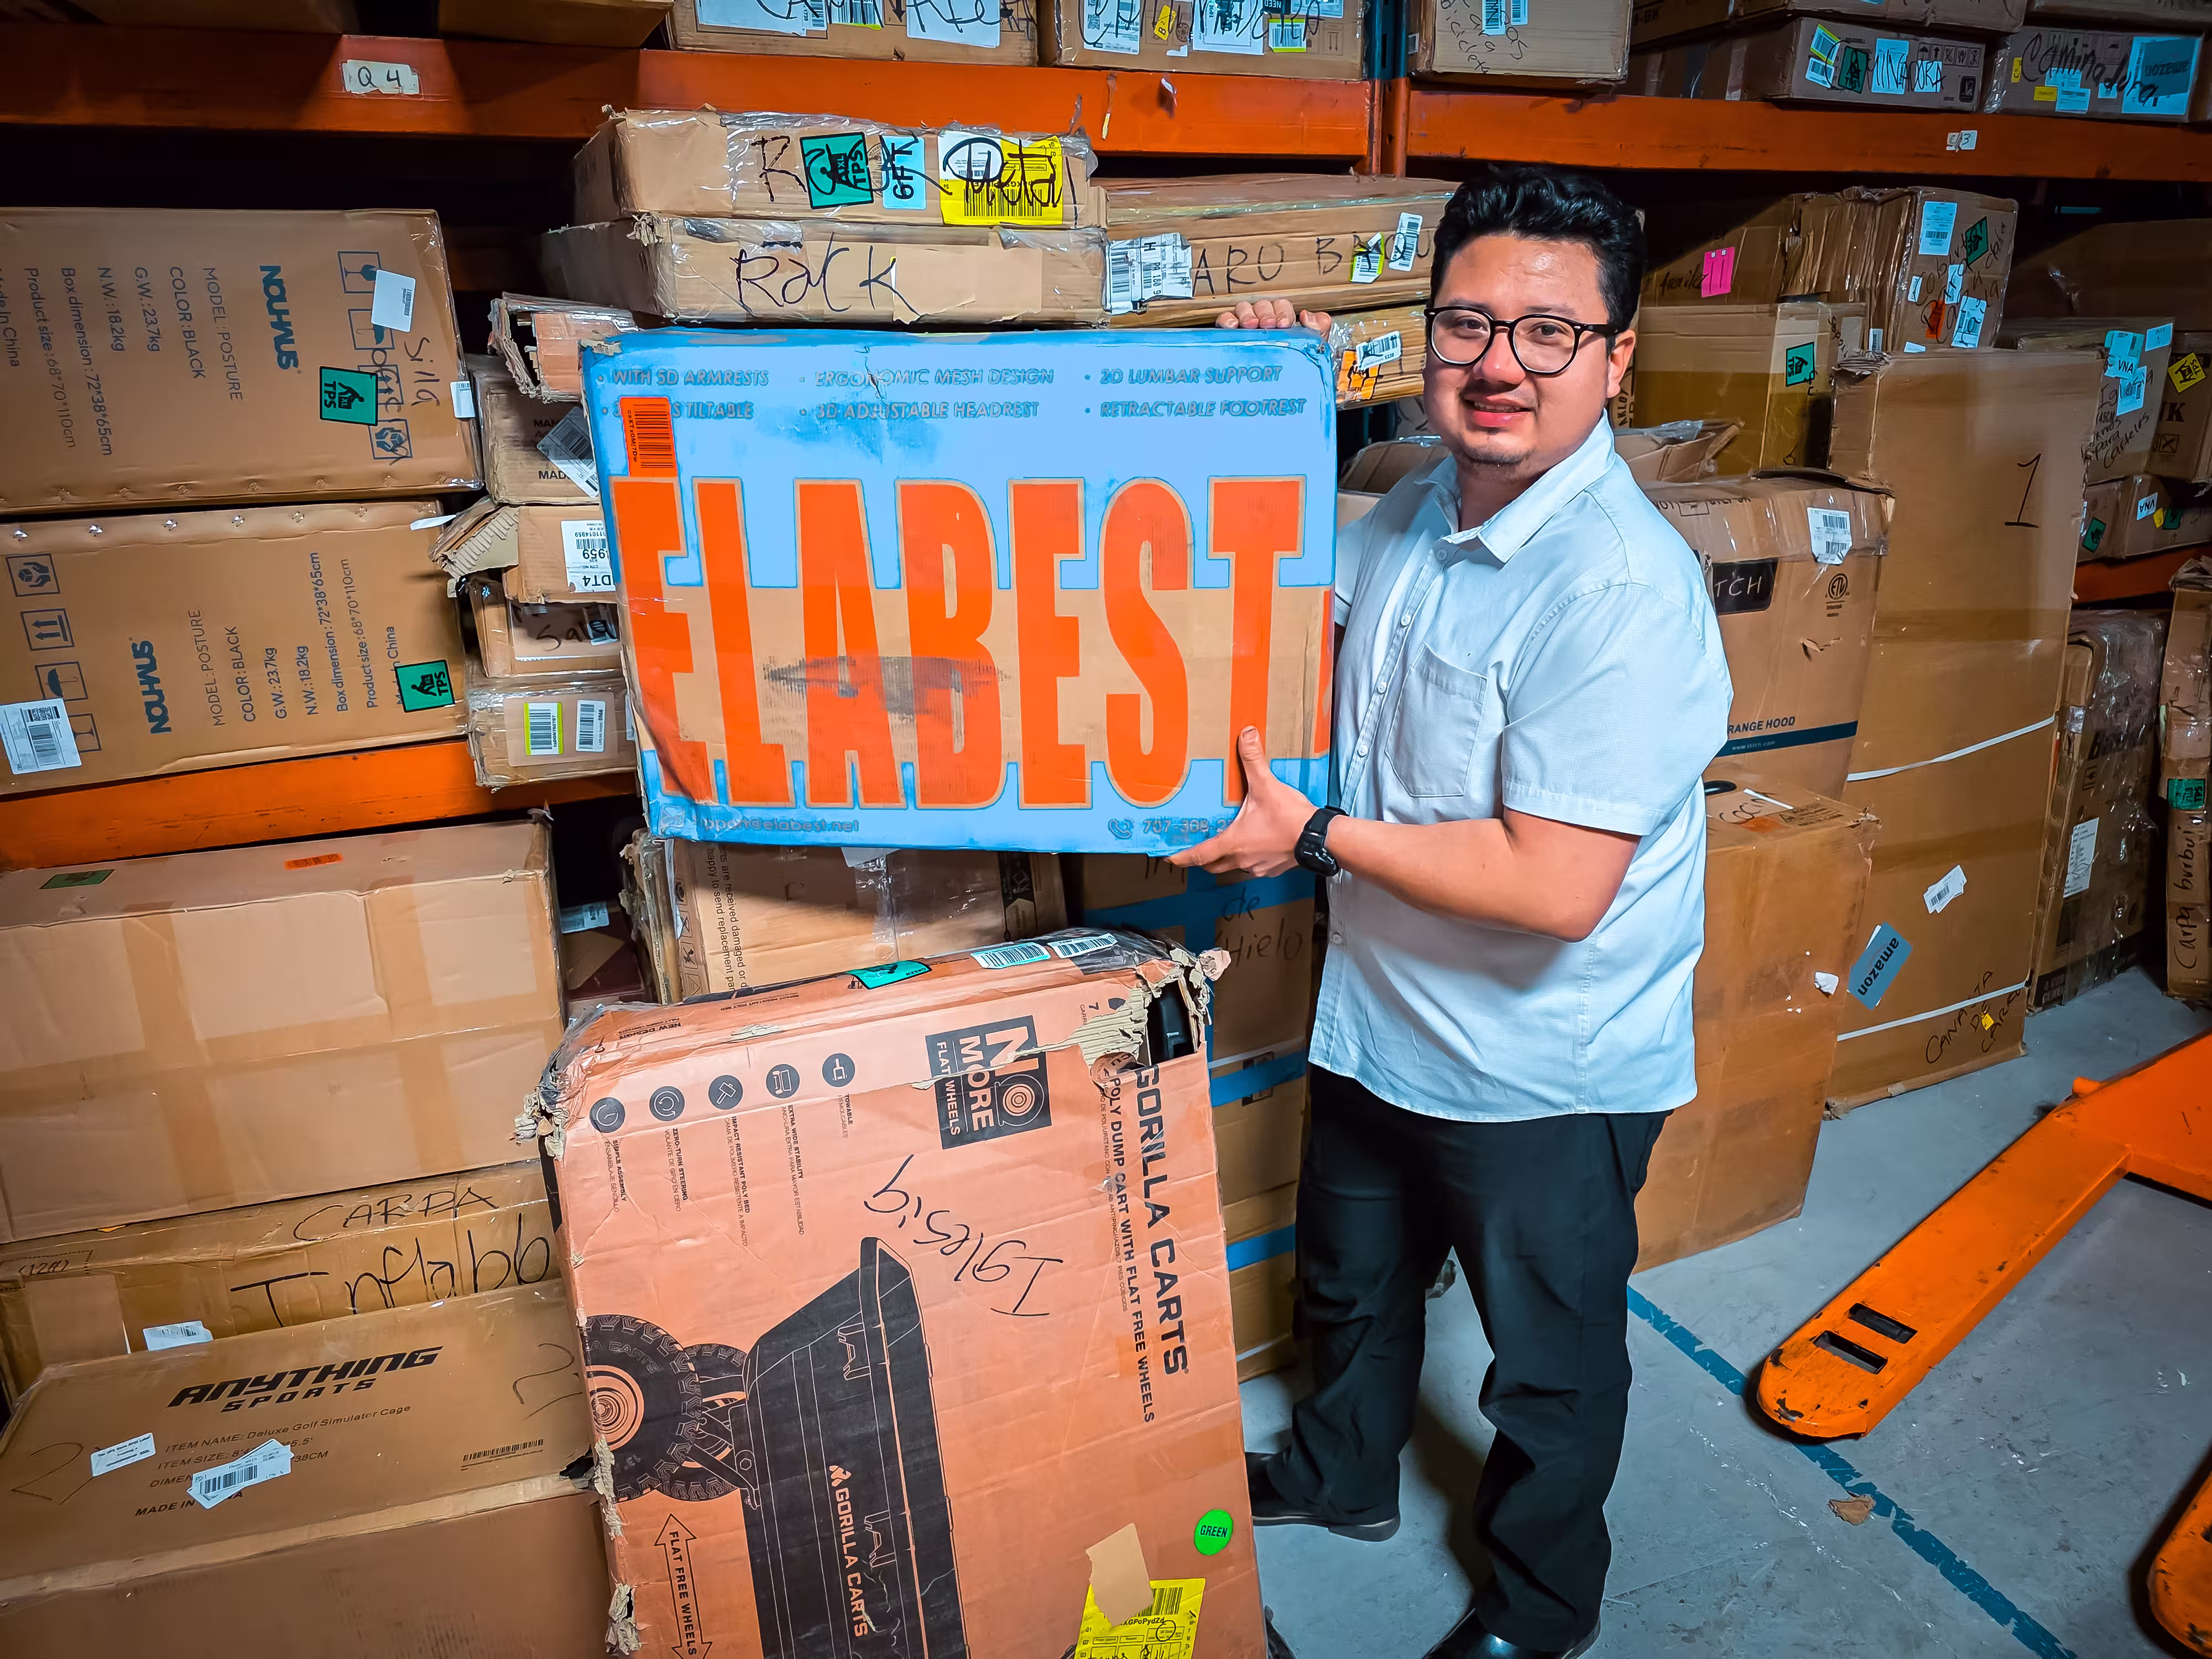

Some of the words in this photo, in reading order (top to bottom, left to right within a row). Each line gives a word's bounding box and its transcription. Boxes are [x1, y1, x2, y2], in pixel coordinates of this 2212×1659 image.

[387, 69, 401, 87] 4
[1964, 133, 1971, 145] 3
[891, 142, 915, 200] 6FT
[1144, 242, 1156, 252] H
[24, 268, 50, 324] Product
[61, 267, 75, 293] Box
[4, 327, 20, 367] China
[182, 330, 206, 379] BLACK
[217, 332, 243, 401] POSTURE
[612, 369, 653, 386] WITH
[684, 369, 769, 386] ARMRESTS
[935, 369, 983, 386] MESH
[988, 368, 1054, 385] DESIGN
[1128, 368, 1201, 385] LUMBAR
[1203, 365, 1283, 384] SUPPORT
[2117, 360, 2135, 375] VNA
[324, 382, 336, 409] TPS
[686, 402, 754, 419] TILTABLE
[816, 403, 838, 420] 3D
[953, 401, 1040, 419] HEADREST
[1099, 400, 1217, 418] RETRACTABLE
[1219, 398, 1307, 418] FOOTREST
[2140, 498, 2156, 514] VNA
[187, 610, 214, 671] POSTURE
[224, 625, 245, 670] BLACK
[385, 626, 399, 659] China
[607, 476, 1308, 809] ELABEST
[337, 690, 348, 712] Box
[361, 664, 378, 708] Product
[434, 671, 449, 696] TPS
[1728, 719, 1764, 735] RANGE
[1766, 716, 1796, 730] HOOD
[712, 880, 719, 889] to
[721, 865, 730, 881] are
[714, 892, 725, 915] send
[726, 883, 739, 922] received
[717, 917, 733, 975] replacement
[732, 925, 747, 968] damaged
[738, 971, 746, 980] or
[1857, 936, 1900, 997] amazon
[619, 1027, 658, 1040] DESIGN
[659, 1022, 682, 1031] NEW
[937, 1041, 951, 1075] FLAT
[945, 1080, 961, 1135] WHEELS
[959, 1035, 994, 1131] MORE
[1109, 1077, 1121, 1110] POLY
[844, 1094, 854, 1125] TOWABLE
[732, 1116, 740, 1142] IMPACT
[788, 1105, 796, 1126] EXTRA
[794, 1146, 804, 1179] STABILITY
[1111, 1121, 1125, 1167] DUMP
[1136, 1064, 1171, 1229] GORILLA
[664, 1129, 674, 1157] VOLANTE
[673, 1194, 681, 1212] CERO
[672, 1128, 684, 1166] ZERO-TURN
[679, 1167, 688, 1201] STEERING
[727, 1137, 733, 1145] DE
[733, 1178, 743, 1214] RESISTENTE
[735, 1143, 745, 1179] RESISTANT
[617, 1166, 627, 1201] ASSEMBLY
[1115, 1172, 1130, 1216] CART
[1121, 1218, 1135, 1264] WITH
[1126, 1267, 1141, 1306] FLAT
[1150, 1237, 1188, 1375] CARTS
[1131, 1310, 1146, 1353] FREE
[167, 1345, 444, 1408] ANYTHING
[1138, 1357, 1155, 1423] WHEELS
[220, 1377, 376, 1413] SPORTS
[165, 1441, 198, 1454] ITEM
[201, 1434, 244, 1449] NAME:
[247, 1427, 289, 1439] Deluxe
[293, 1420, 319, 1432] Golf
[319, 1410, 378, 1427] Simulator
[380, 1404, 411, 1416] Cage
[157, 1458, 191, 1470] ITEM
[193, 1452, 230, 1464] SIZE:
[134, 1501, 174, 1518] MADE
[175, 1499, 196, 1510] IN
[669, 1530, 682, 1564] FLAT
[1199, 1525, 1228, 1538] GREEN
[834, 1488, 858, 1569] GORILLA
[846, 1572, 869, 1639] CARTS
[675, 1566, 688, 1600] FREE
[681, 1603, 697, 1657] WHEELS
